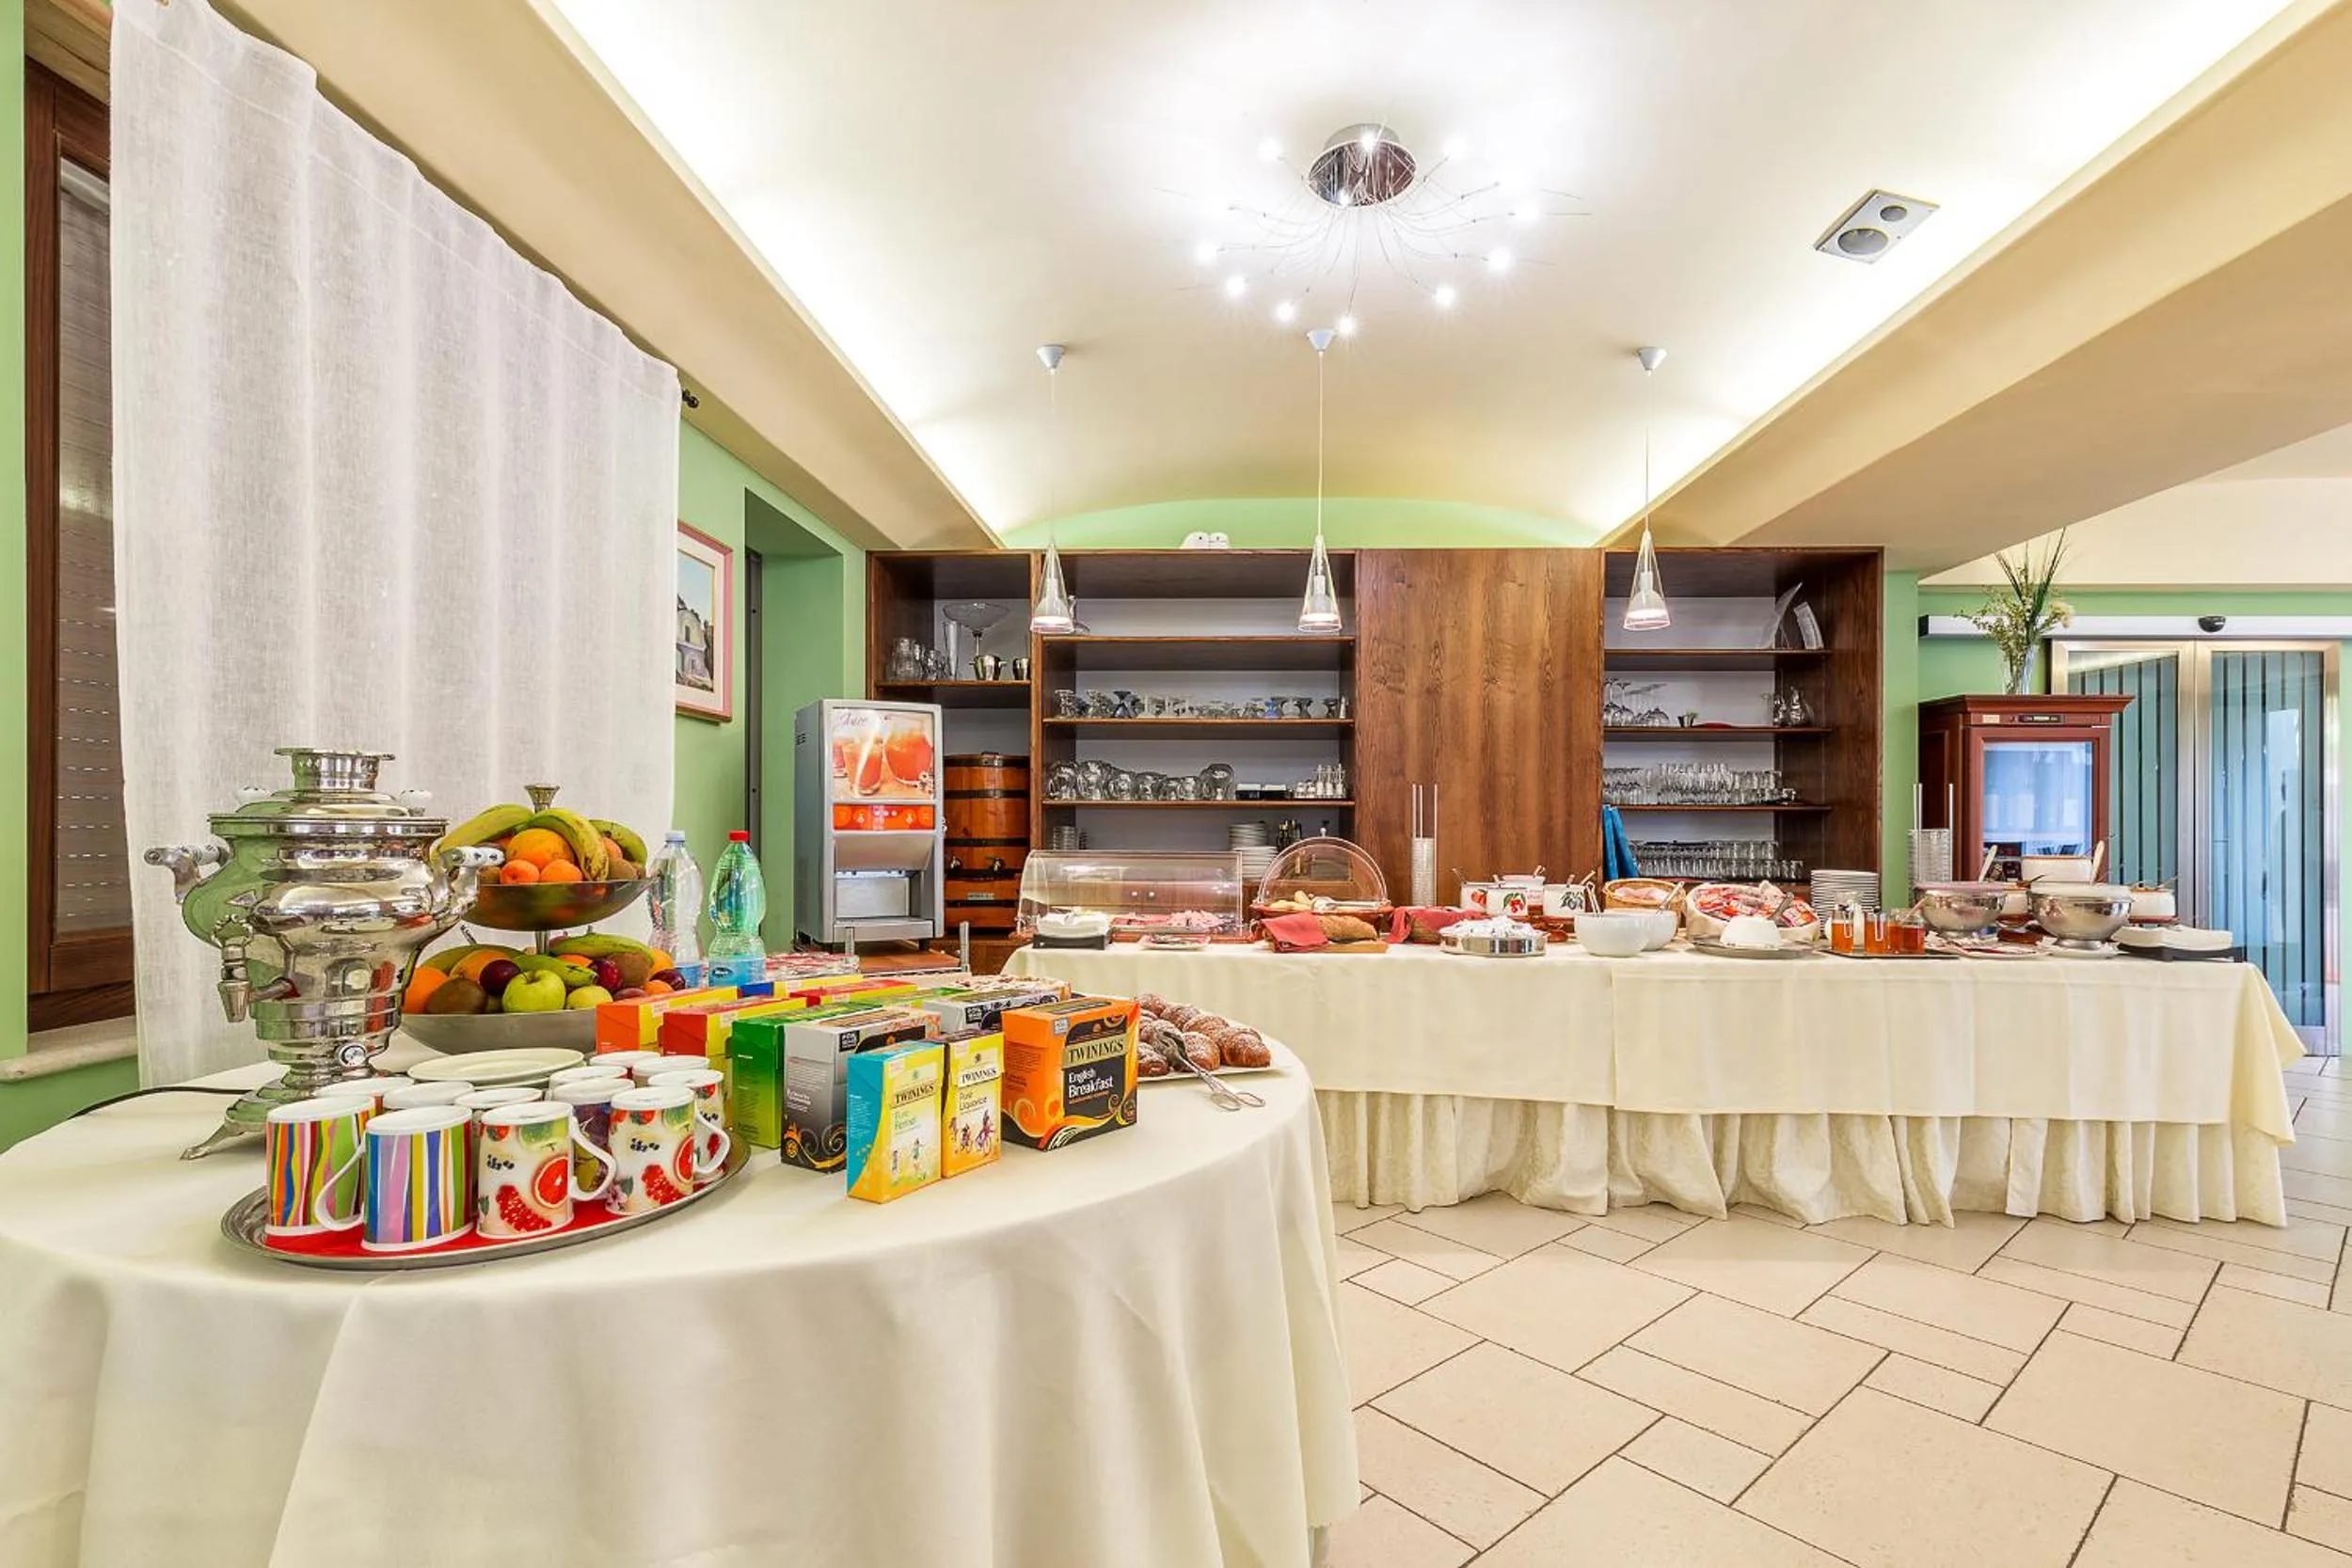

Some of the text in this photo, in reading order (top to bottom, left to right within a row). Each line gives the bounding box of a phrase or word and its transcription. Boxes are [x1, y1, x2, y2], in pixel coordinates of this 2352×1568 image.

[1069, 1039, 1124, 1064] TWININGS
[961, 1068, 997, 1085] TWININGS
[1069, 1068, 1097, 1084] English
[895, 1084, 934, 1104] TWININGS
[1069, 1076, 1114, 1099] Breakfast
